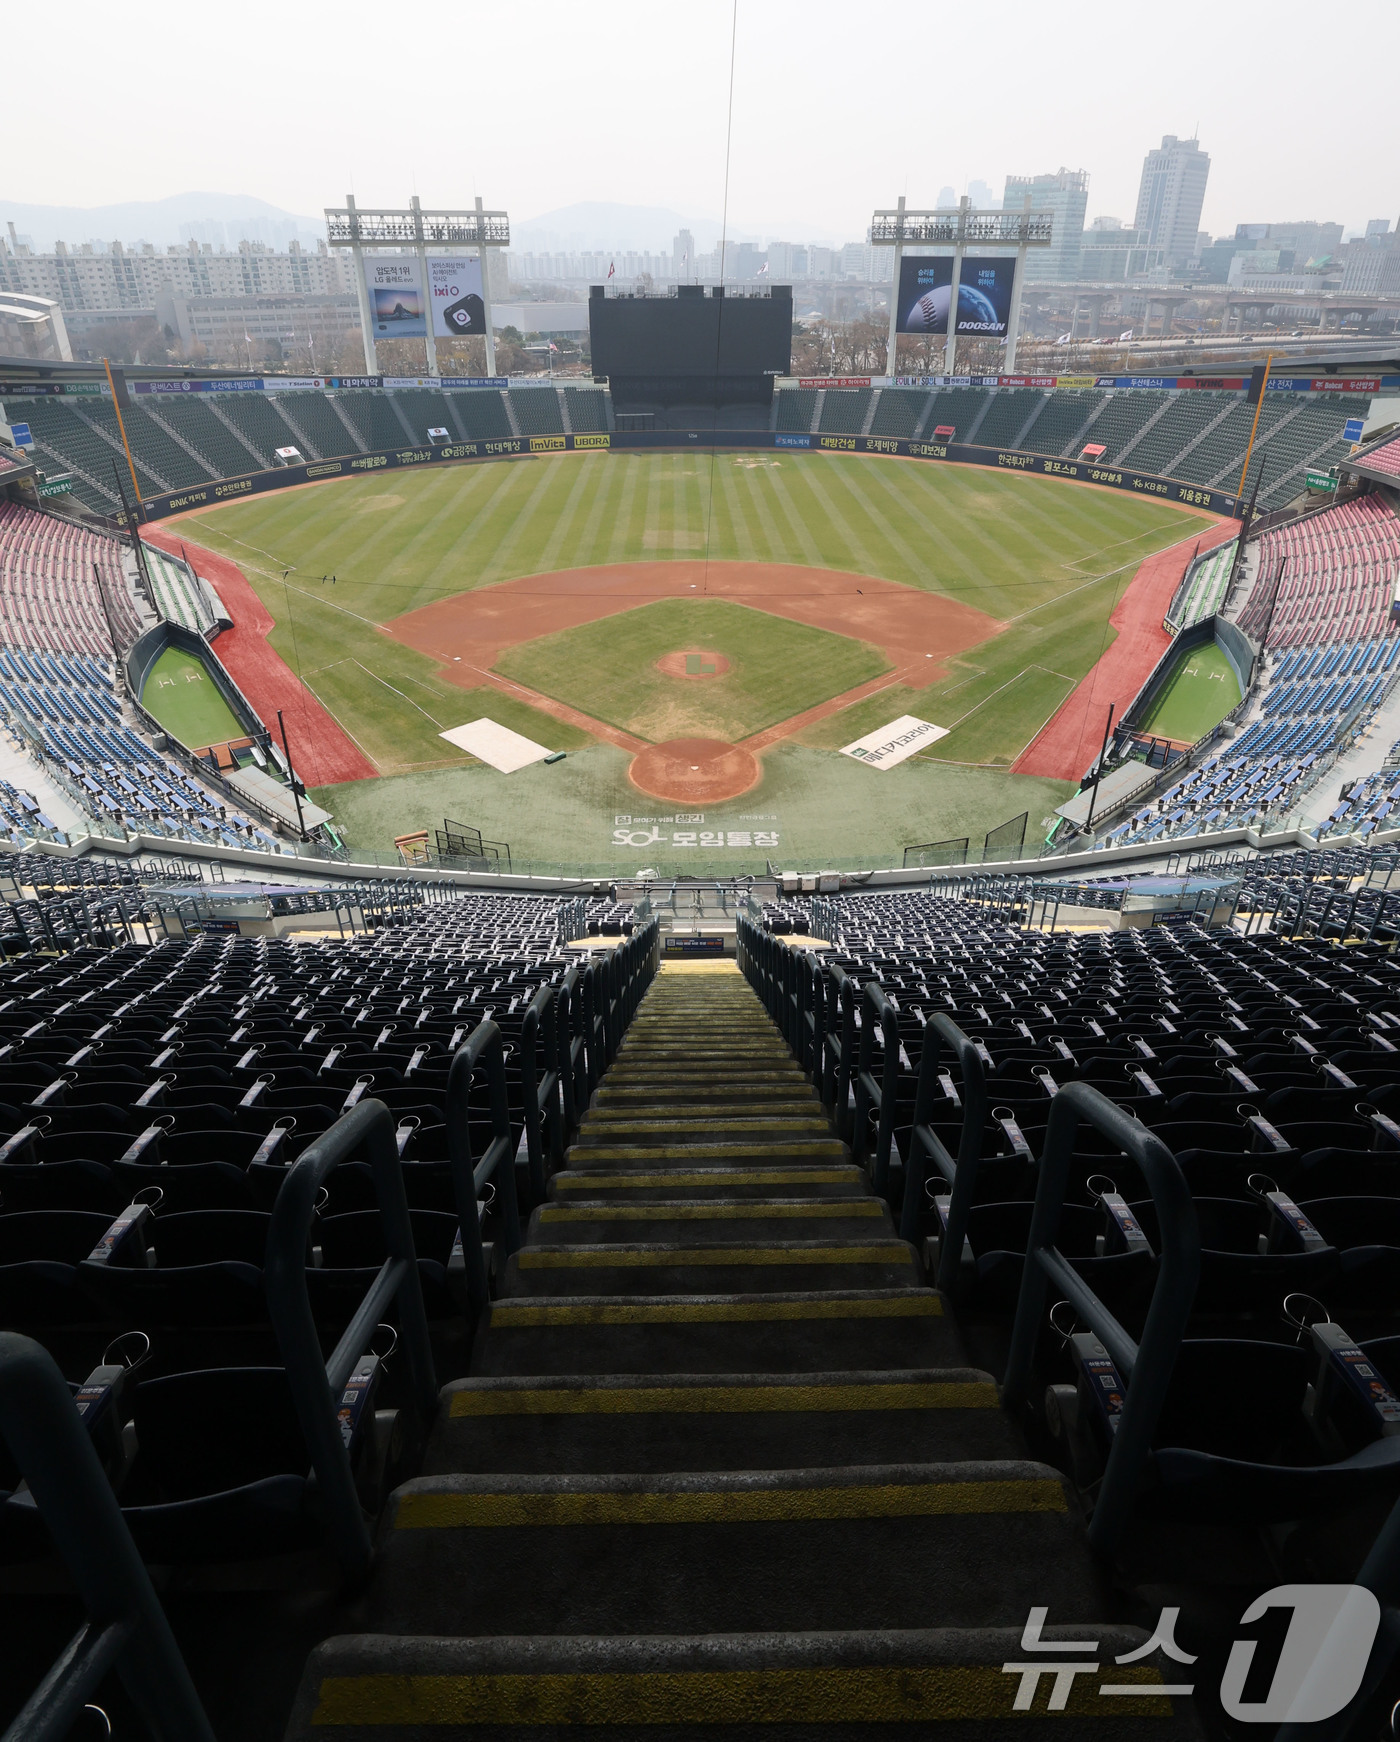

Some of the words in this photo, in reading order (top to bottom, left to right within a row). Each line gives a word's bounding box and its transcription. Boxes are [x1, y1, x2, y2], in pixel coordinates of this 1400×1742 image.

[376, 266, 398, 276] 압도적
[399, 266, 410, 276] 1위
[918, 268, 934, 277] 승리를
[978, 270, 996, 278] 내일을
[958, 321, 1005, 331] DOOSAN
[342, 378, 378, 388] 대화제약
[892, 378, 910, 386] SEOUL
[922, 378, 936, 386] SOUL
[1130, 379, 1163, 387] 두산테스나
[1277, 379, 1293, 389] 전자
[1349, 381, 1375, 390] 두산밥캣
[485, 441, 521, 453] 현대해상
[575, 437, 609, 447] UBORA
[820, 437, 856, 449] 대방건설
[866, 439, 898, 452] 로제비앙
[453, 445, 477, 457] 금강주택
[921, 445, 947, 457] 대보건설
[222, 480, 252, 493] 유안타증권
[1179, 488, 1211, 506] 키움증권
[862, 723, 936, 763] 메디카코리아
[676, 814, 703, 823] 생긴
[612, 826, 668, 847] SOL
[672, 831, 779, 847] 모임통장
